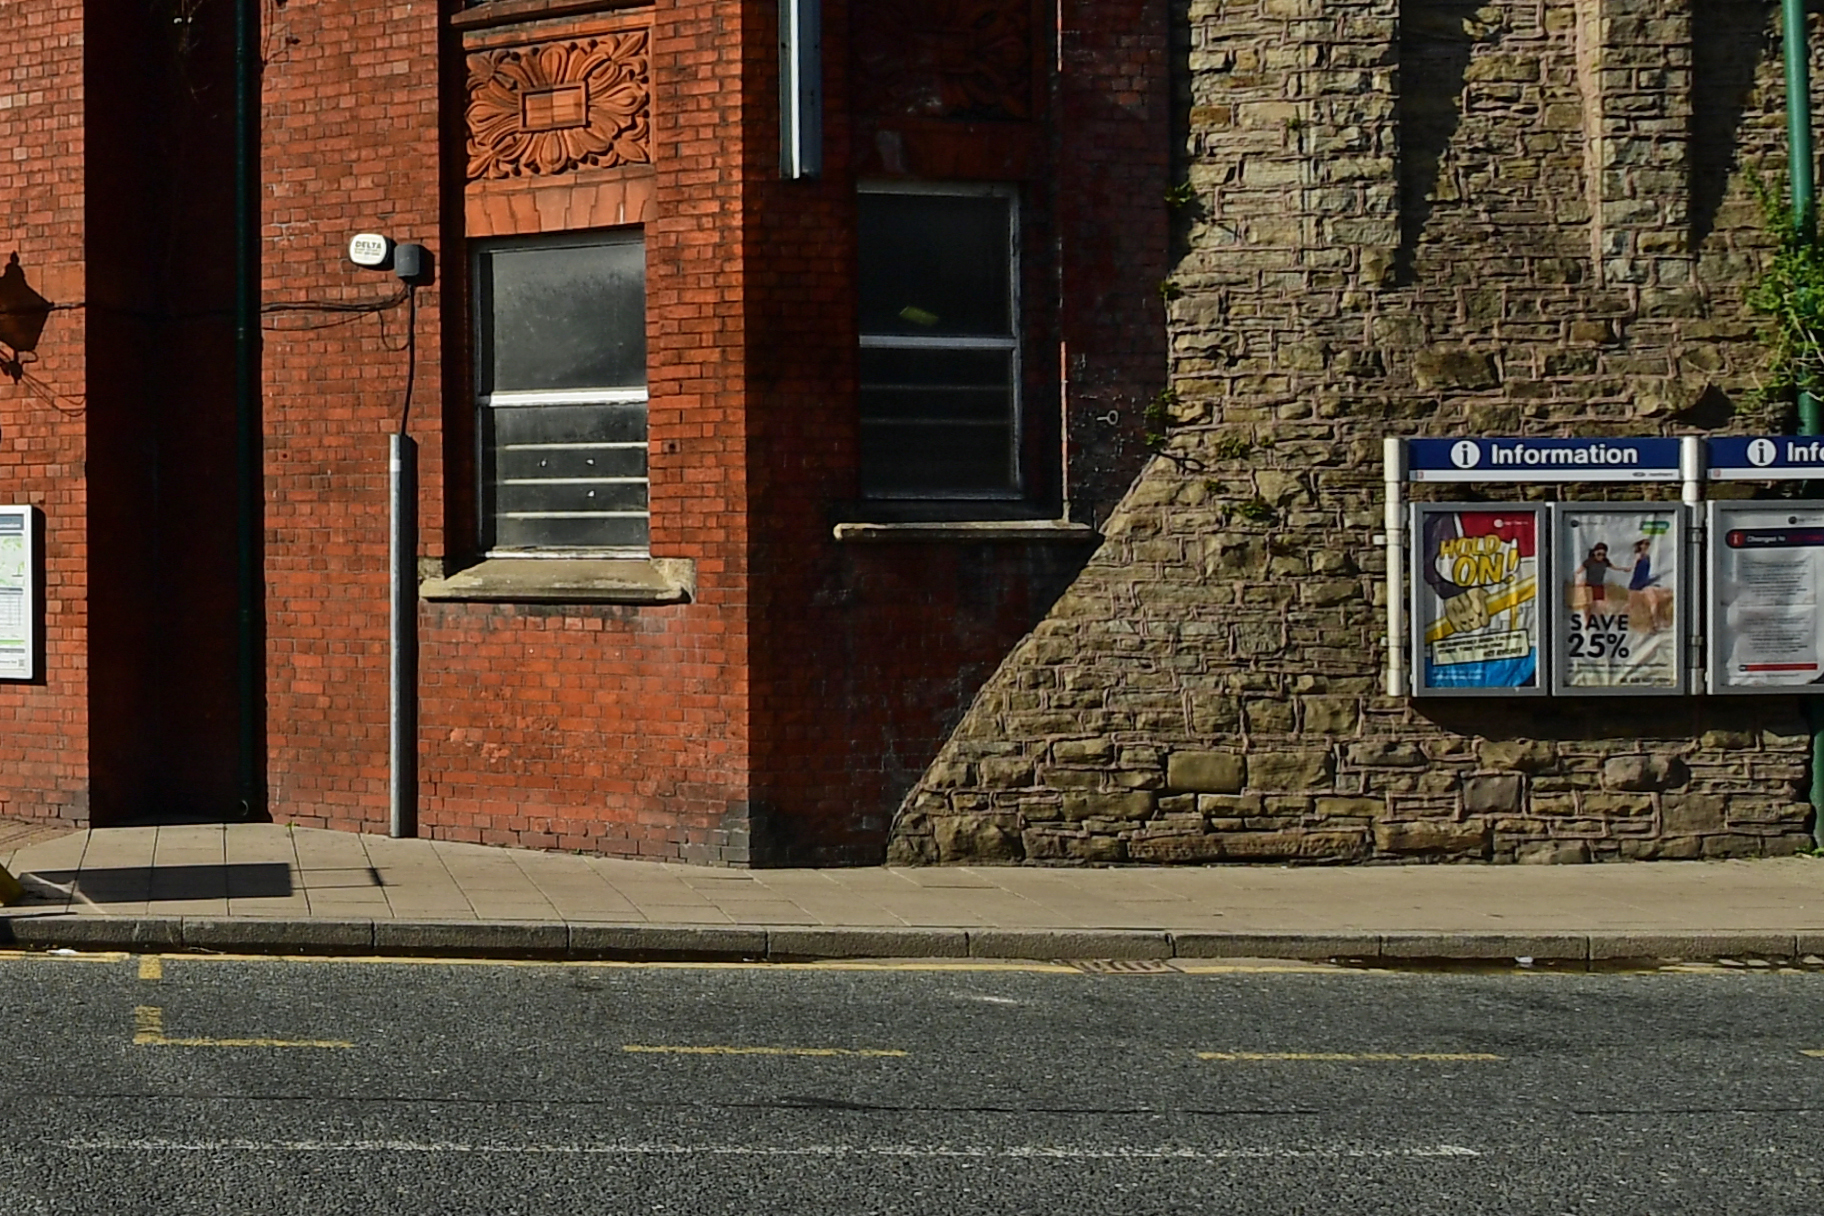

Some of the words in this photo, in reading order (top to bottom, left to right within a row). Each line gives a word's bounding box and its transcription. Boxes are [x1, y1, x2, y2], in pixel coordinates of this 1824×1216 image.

[355, 241, 381, 249] DELTA
[1492, 444, 1638, 465] Information
[1439, 534, 1502, 559] HOLD
[1452, 548, 1518, 587] ON!
[1571, 614, 1628, 631] SAVE
[1567, 634, 1630, 658] 25%
